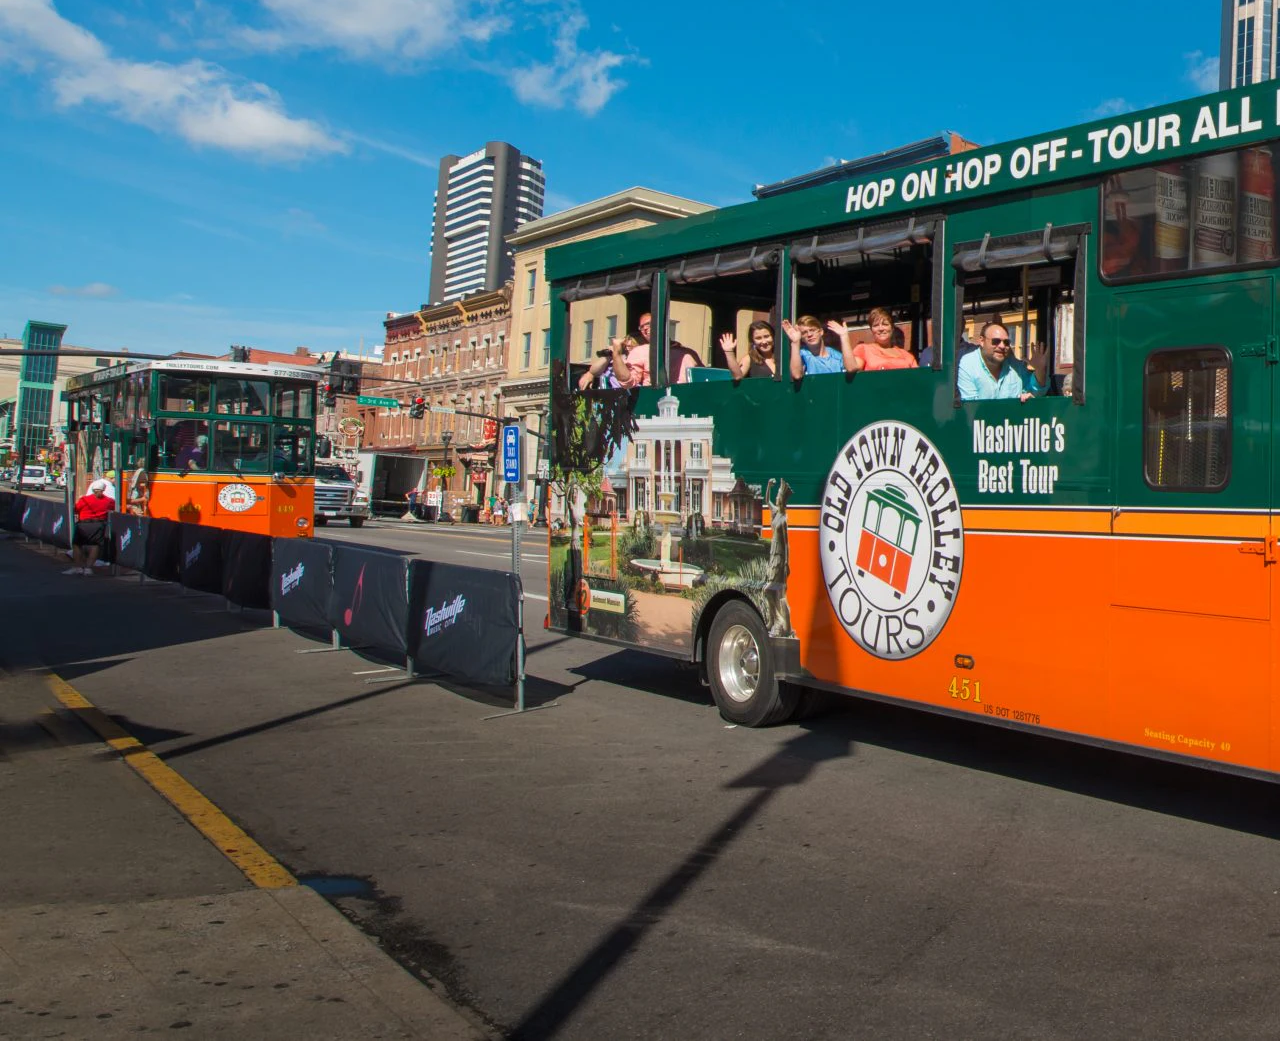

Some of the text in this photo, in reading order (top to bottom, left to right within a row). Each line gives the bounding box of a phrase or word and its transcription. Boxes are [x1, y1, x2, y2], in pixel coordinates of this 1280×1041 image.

[844, 179, 896, 214] HOP
[901, 166, 938, 202] ON
[944, 153, 1002, 194] HOP
[1009, 137, 1069, 180] OFF
[1086, 112, 1181, 163] TOUR
[1190, 102, 1264, 143] ALL
[507, 447, 516, 457] TAXI
[848, 426, 906, 479] TOWN
[973, 417, 1065, 453] Nashville's
[506, 459, 517, 469] STAND
[978, 459, 1058, 494] Best Tour
[822, 470, 853, 534] OLD
[907, 438, 961, 602] TROLLEY
[424, 594, 466, 637] Nashville
[828, 556, 925, 655] TOURS
[948, 675, 982, 704] 451
[983, 704, 1041, 724] US DOT 1281776
[1144, 727, 1176, 744] Seating
[1177, 734, 1216, 751] Capacity
